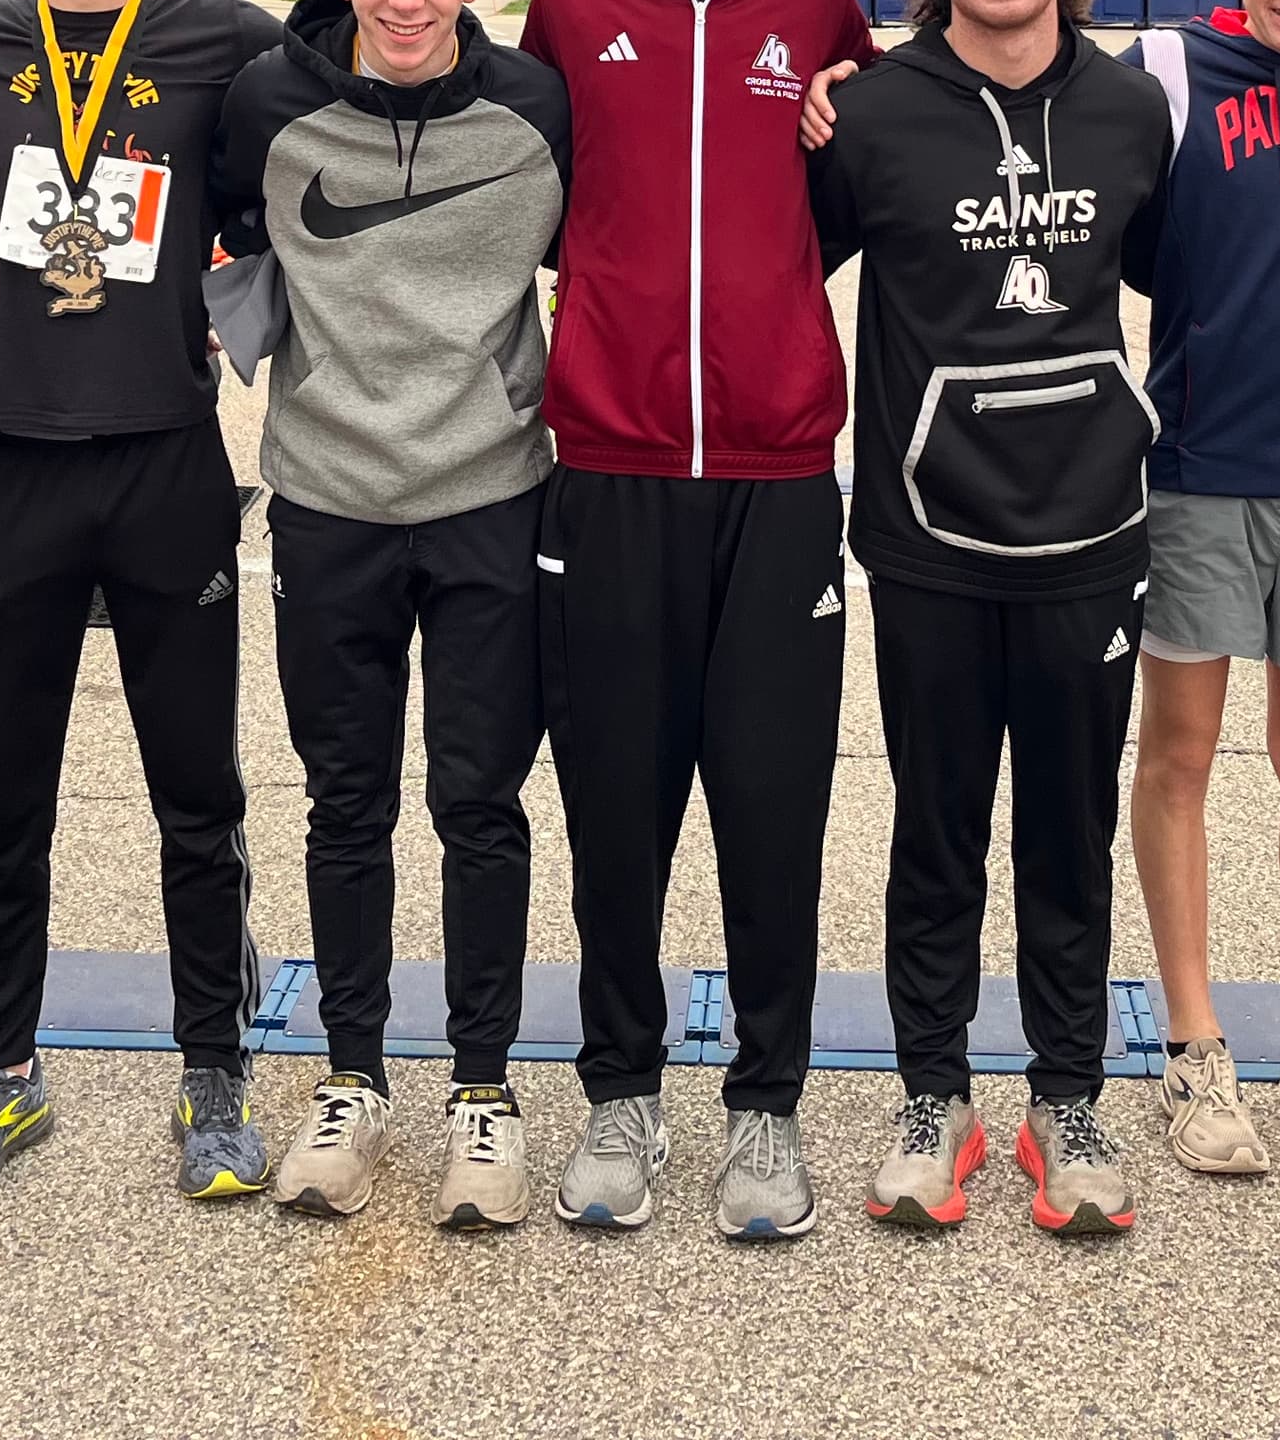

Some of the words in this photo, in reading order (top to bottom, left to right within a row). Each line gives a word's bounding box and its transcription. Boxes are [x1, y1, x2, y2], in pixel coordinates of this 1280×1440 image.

[752, 34, 800, 79] AQ
[745, 77, 772, 87] CROSS
[773, 80, 803, 92] COUNTRY
[750, 87, 776, 97] TRACK
[782, 91, 800, 101] FIELD
[996, 163, 1041, 176] adas
[951, 188, 1097, 233] SANTS
[76, 223, 96, 239] THE
[88, 231, 106, 250] PIE
[960, 234, 1019, 252] TRACK
[1025, 233, 1037, 247] &
[1043, 229, 1091, 245] FIELD
[997, 256, 1066, 313] AQ
